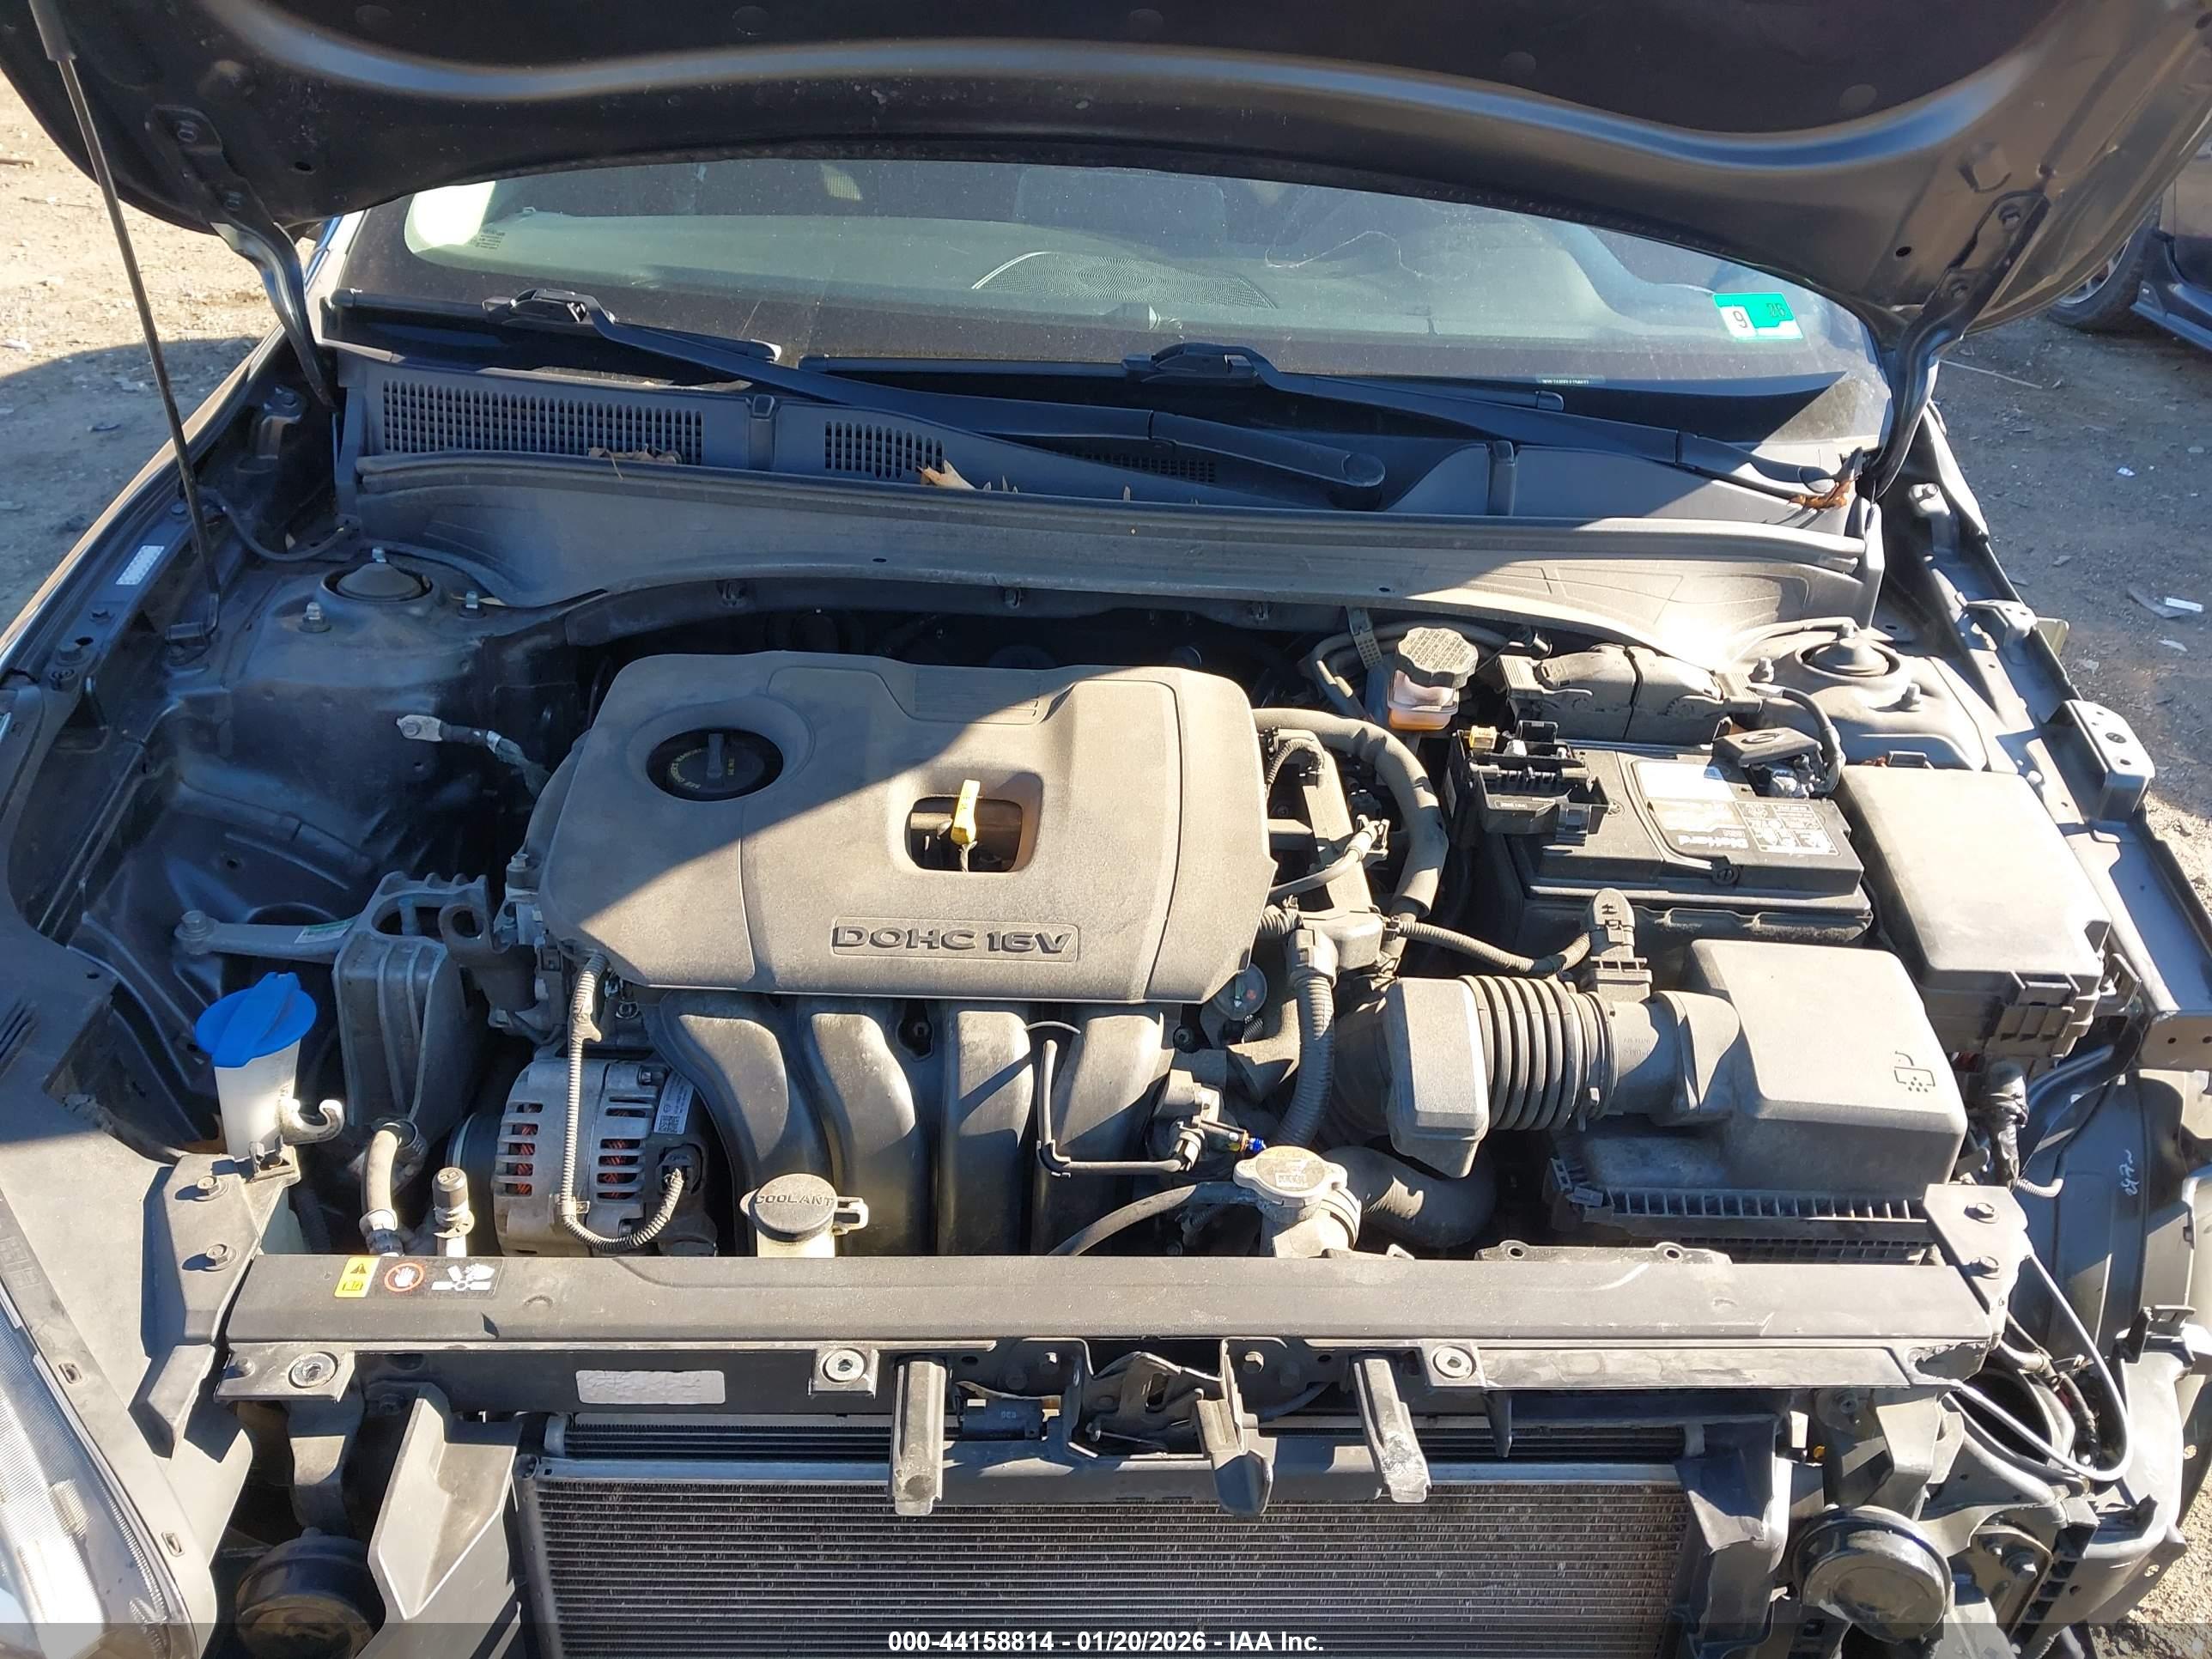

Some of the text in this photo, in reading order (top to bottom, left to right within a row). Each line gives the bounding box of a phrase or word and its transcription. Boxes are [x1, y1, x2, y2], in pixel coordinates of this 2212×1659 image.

[831, 925, 1073, 954] DOHC 16V
[754, 1194, 835, 1207] COOLANT
